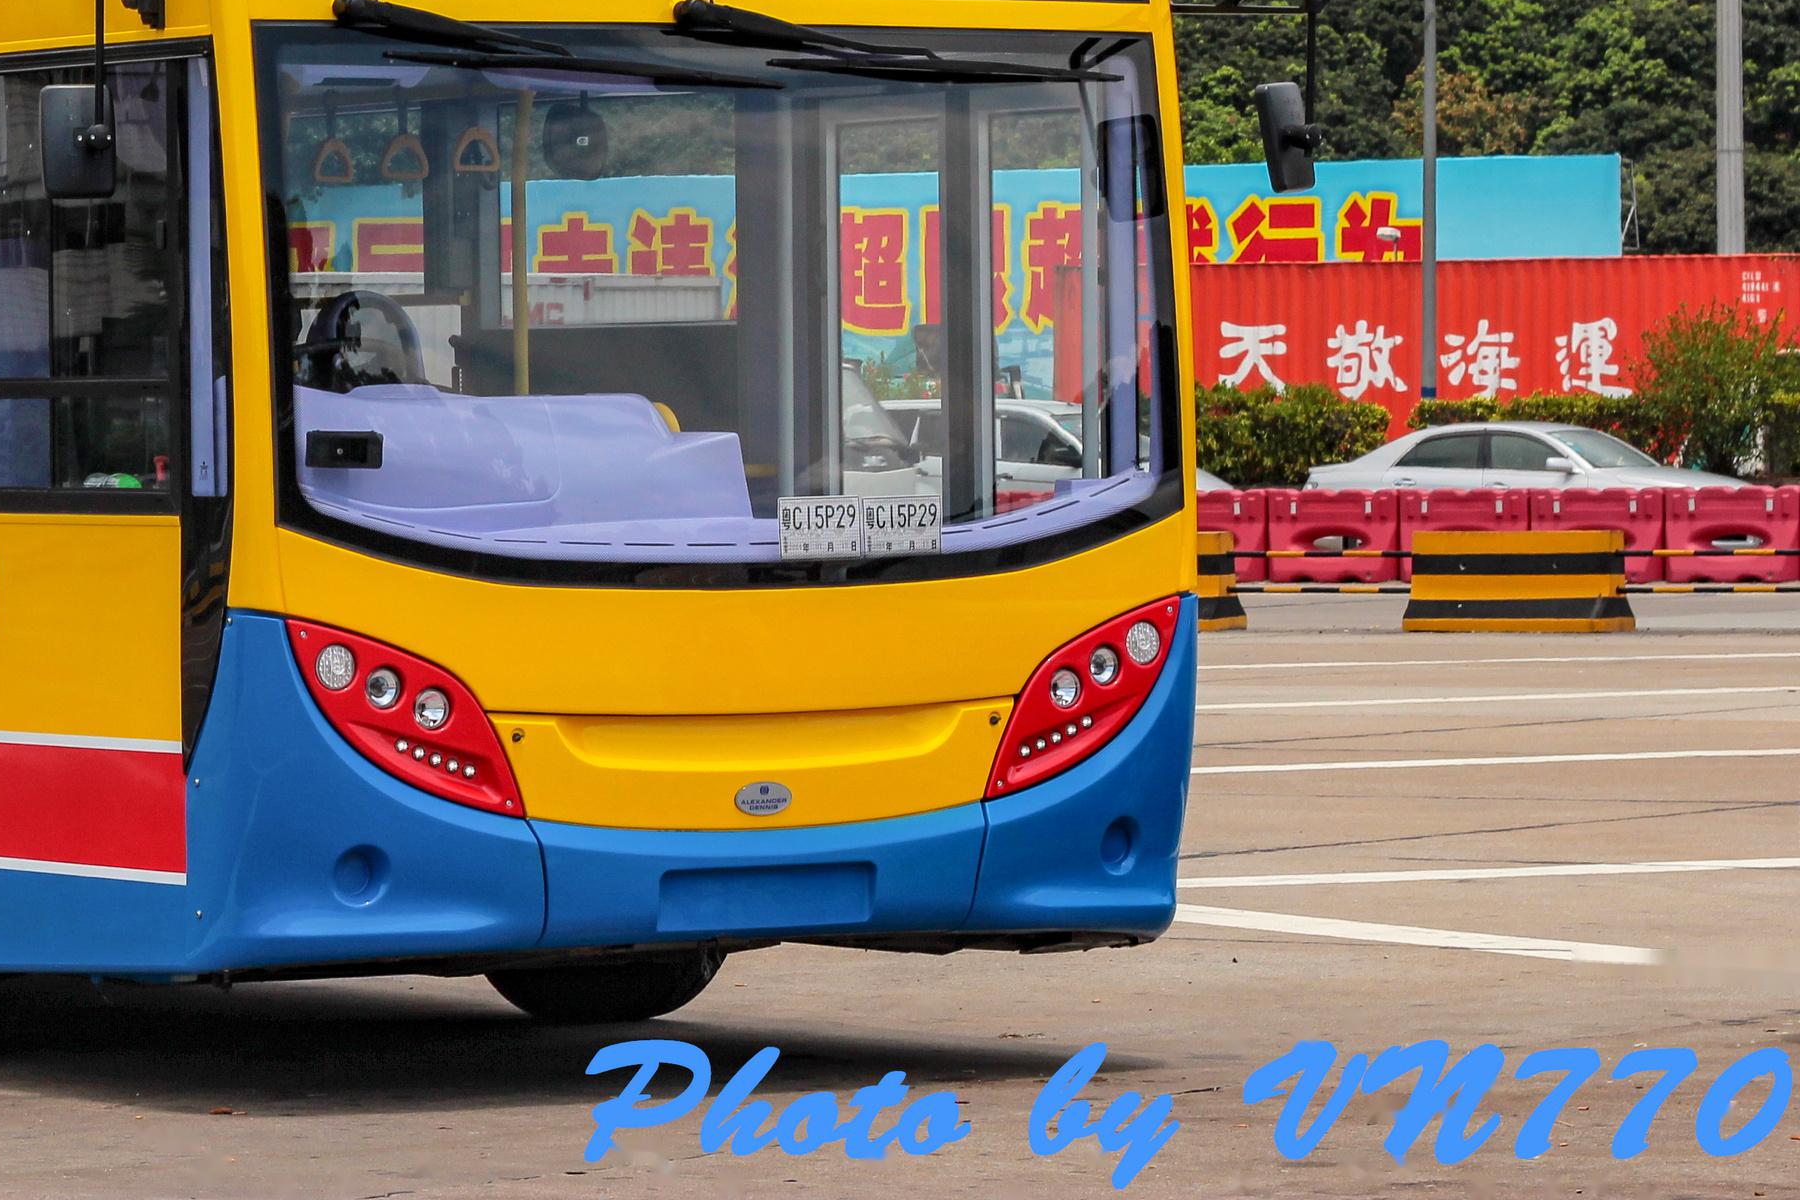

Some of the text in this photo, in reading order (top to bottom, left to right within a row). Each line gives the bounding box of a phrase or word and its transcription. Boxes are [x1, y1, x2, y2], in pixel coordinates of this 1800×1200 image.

[1218, 317, 1633, 400] 天敬海運
[741, 797, 787, 805] ALEXANDER
[749, 803, 779, 811] DENNIS
